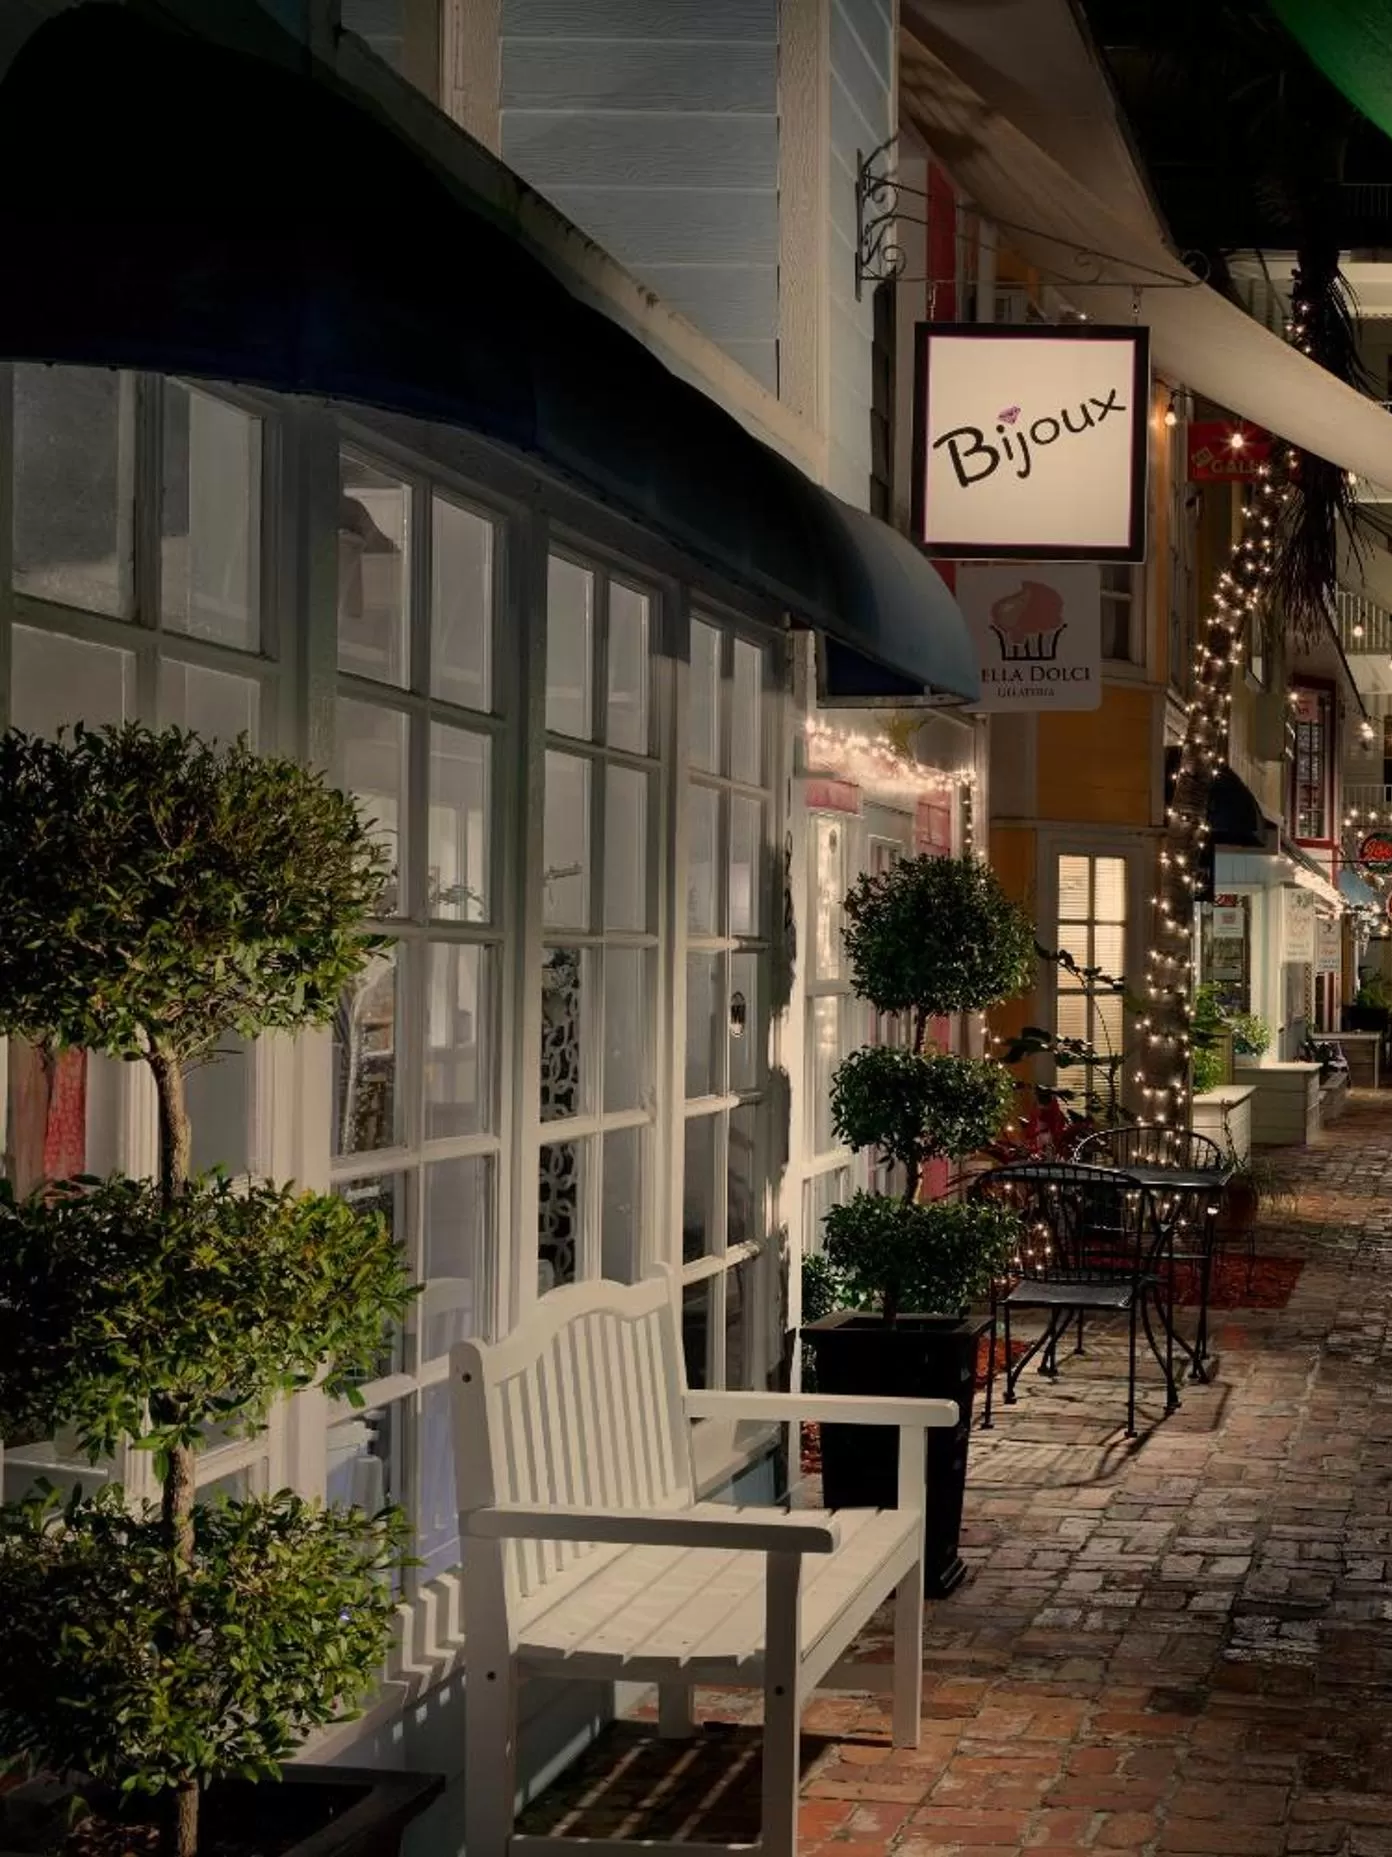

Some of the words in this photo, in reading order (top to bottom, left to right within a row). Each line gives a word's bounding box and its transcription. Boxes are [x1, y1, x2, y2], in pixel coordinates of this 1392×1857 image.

[932, 388, 1127, 488] Bijoux
[981, 667, 1024, 682] ELLA
[1031, 665, 1090, 682] DOLCI
